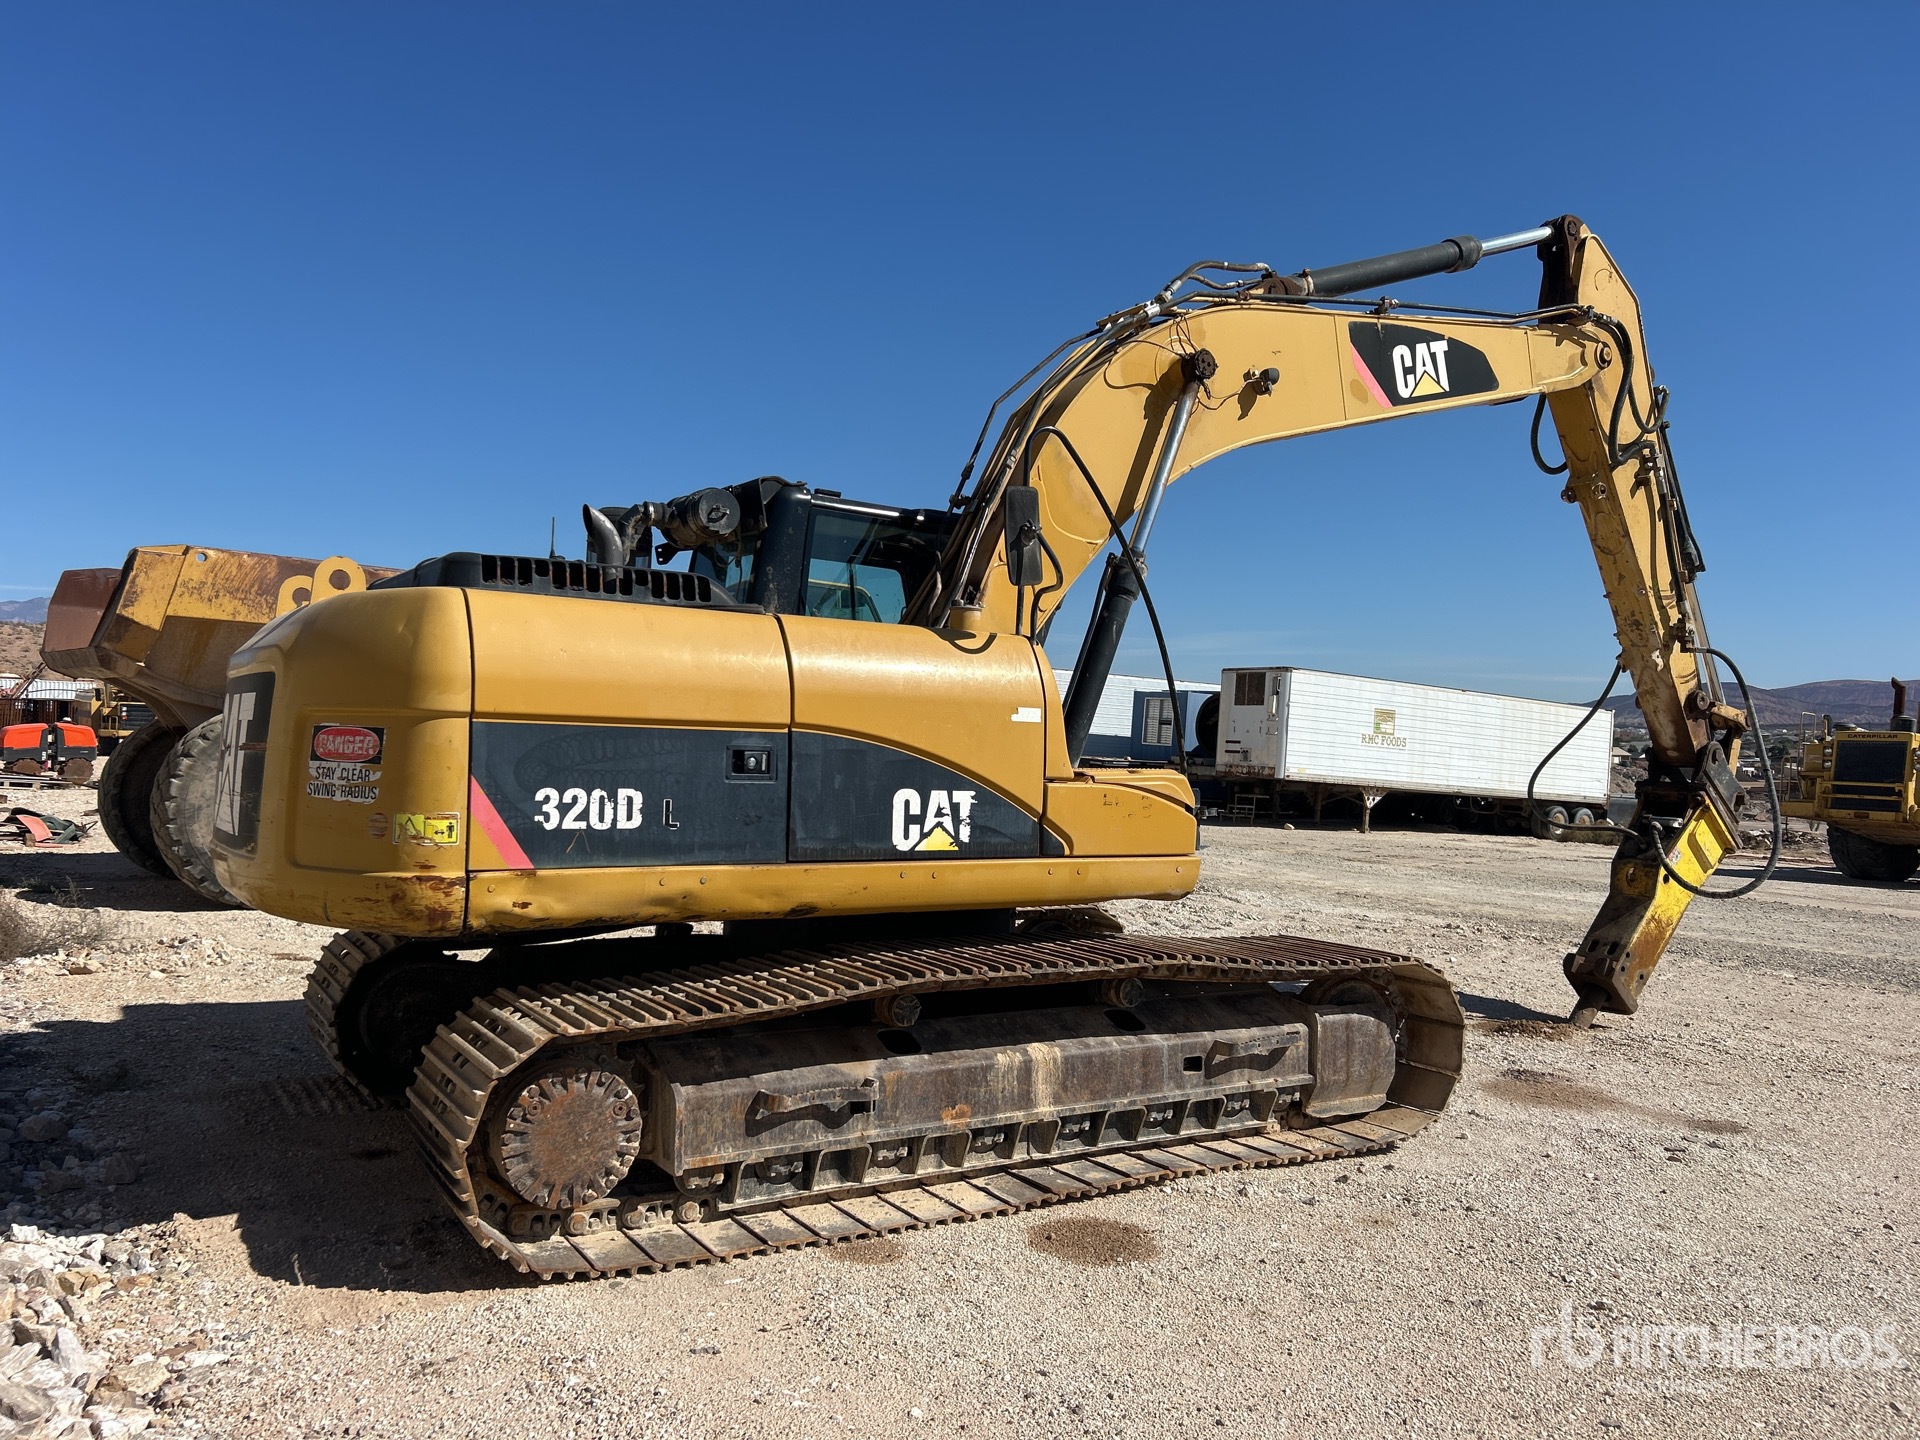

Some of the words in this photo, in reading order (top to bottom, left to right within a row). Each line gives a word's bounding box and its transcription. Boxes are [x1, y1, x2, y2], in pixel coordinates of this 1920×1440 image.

[1392, 339, 1450, 399] CAT
[318, 734, 374, 755] DANGER
[1380, 735, 1407, 748] FOODS
[315, 766, 337, 780] STAY
[340, 767, 371, 782] CLEAR
[307, 782, 336, 797] SWING
[340, 784, 377, 800] RADIUS
[534, 787, 643, 830] 320D
[662, 798, 680, 830] L
[892, 788, 978, 851] CAT
